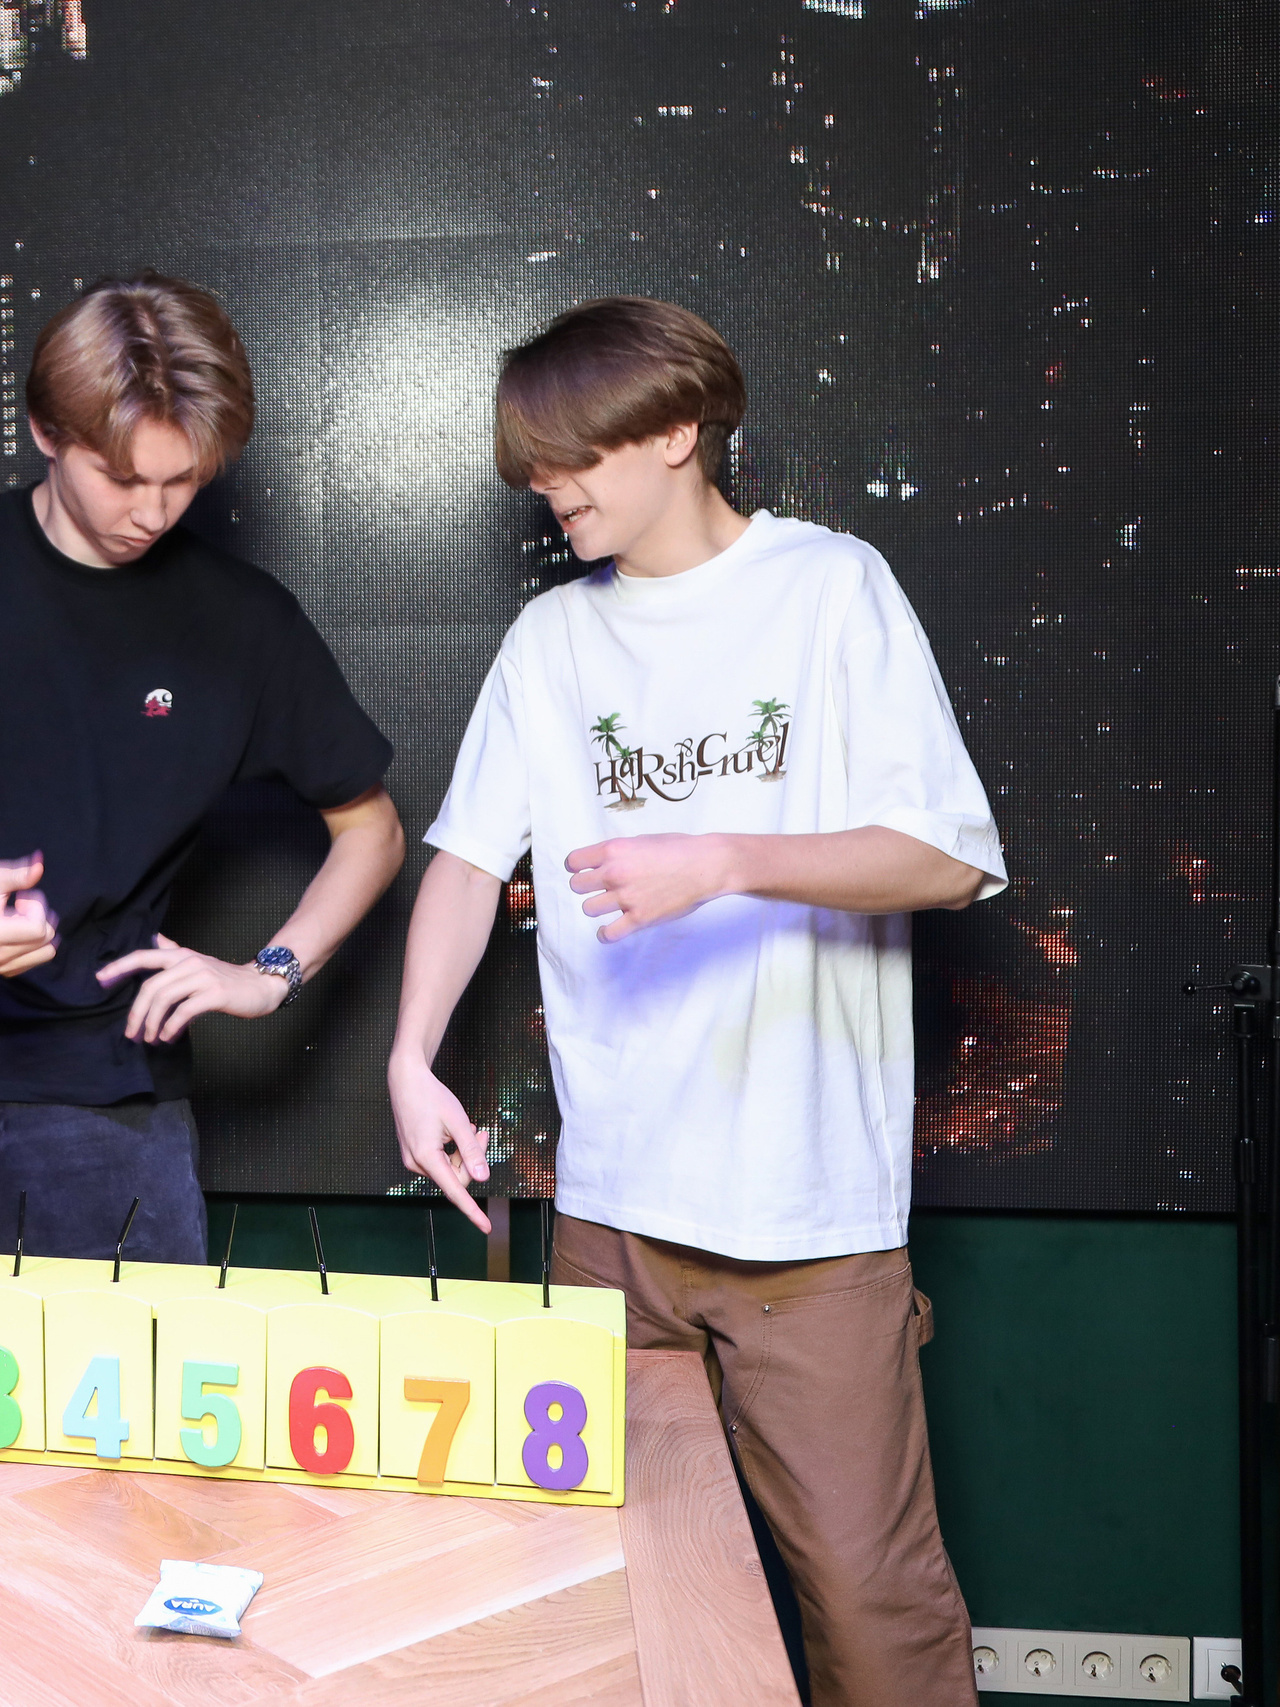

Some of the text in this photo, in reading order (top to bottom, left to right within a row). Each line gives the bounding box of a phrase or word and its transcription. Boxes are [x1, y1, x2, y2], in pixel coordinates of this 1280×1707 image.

[62, 1354, 129, 1459] 4
[179, 1359, 242, 1468] 5
[288, 1365, 355, 1475] 6
[403, 1375, 471, 1484] 7
[521, 1380, 589, 1491] 8
[170, 1599, 216, 1612] AURA
